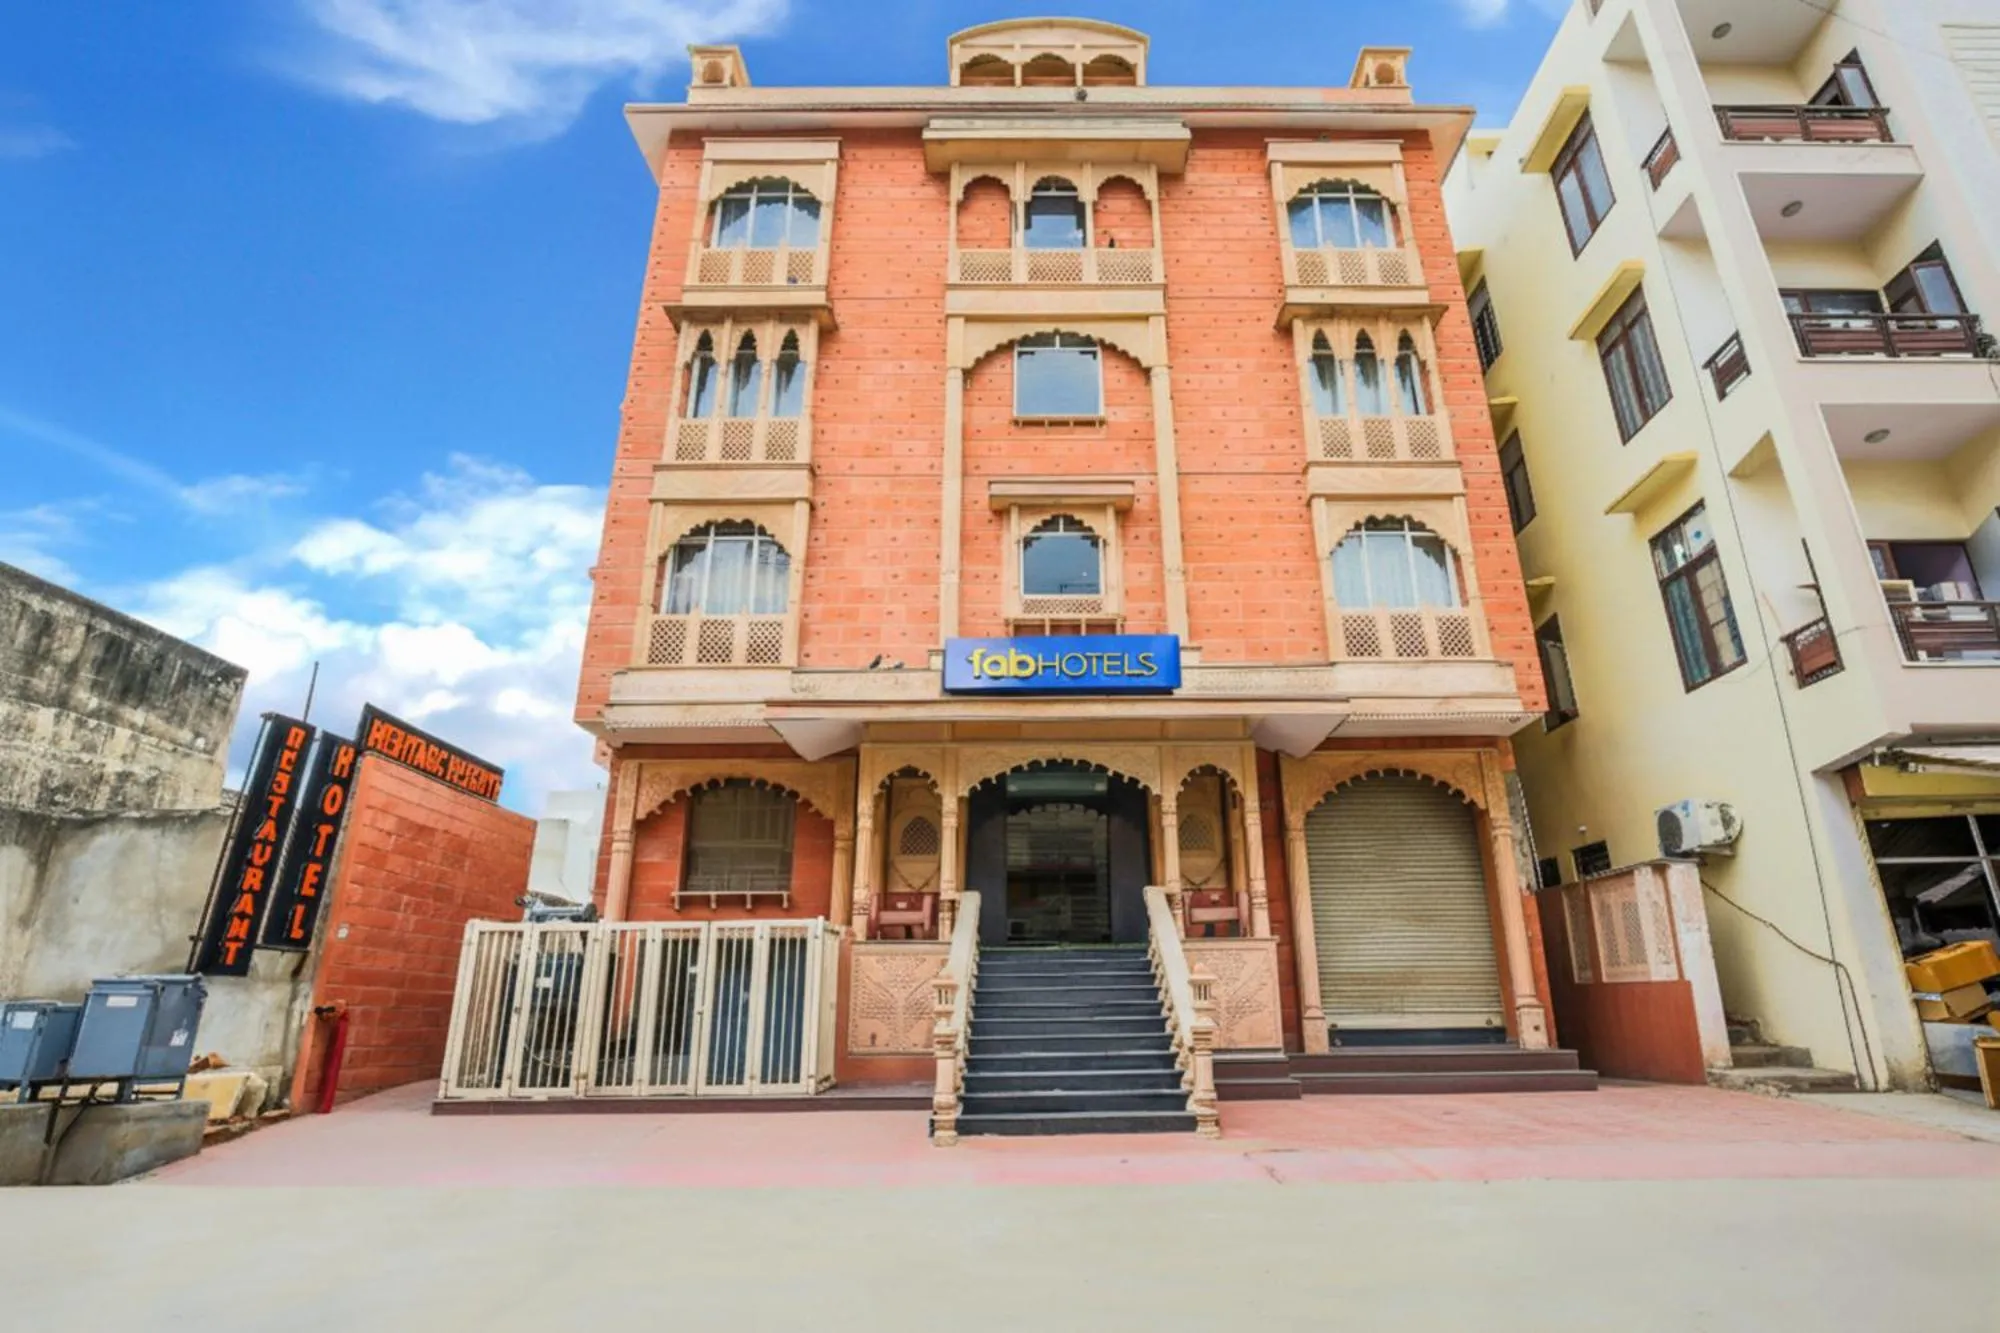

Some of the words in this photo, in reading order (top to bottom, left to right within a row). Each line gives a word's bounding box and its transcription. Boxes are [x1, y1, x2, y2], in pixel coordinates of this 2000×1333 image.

[966, 647, 1159, 678] fabHOTELS
[367, 718, 449, 777] HERITAGE
[224, 725, 307, 966] RESTAURANT
[290, 744, 356, 940] HOTEL
